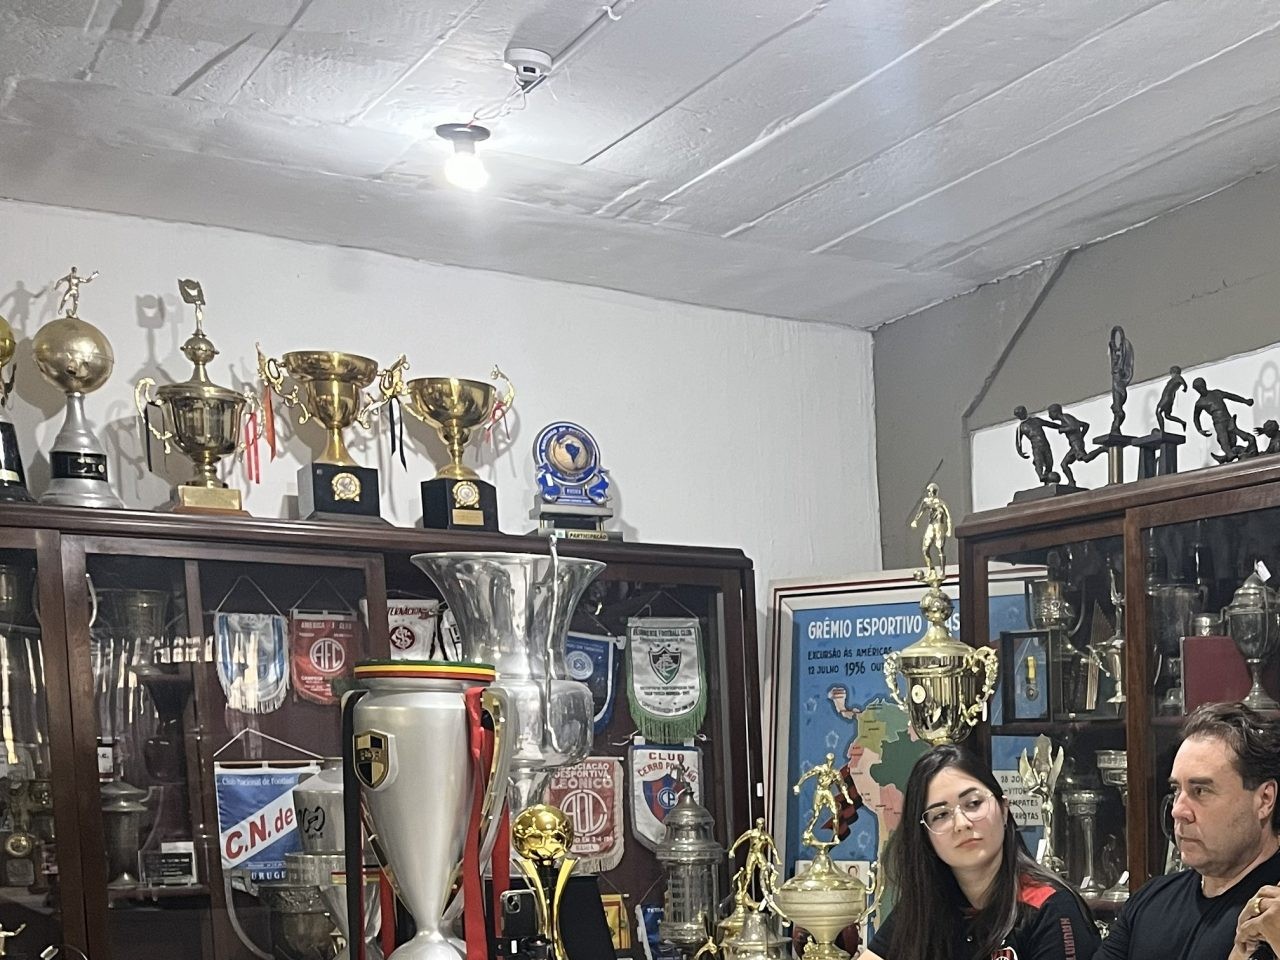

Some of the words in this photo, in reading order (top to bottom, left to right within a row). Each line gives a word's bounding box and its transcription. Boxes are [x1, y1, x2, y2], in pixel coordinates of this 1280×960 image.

[808, 617, 851, 639] GRÊMIO
[857, 615, 922, 637] ESPORTIVO
[808, 648, 841, 661] EXCURSÃO
[816, 665, 839, 674] JULHO
[844, 661, 865, 677] 1956
[274, 807, 294, 833] de
